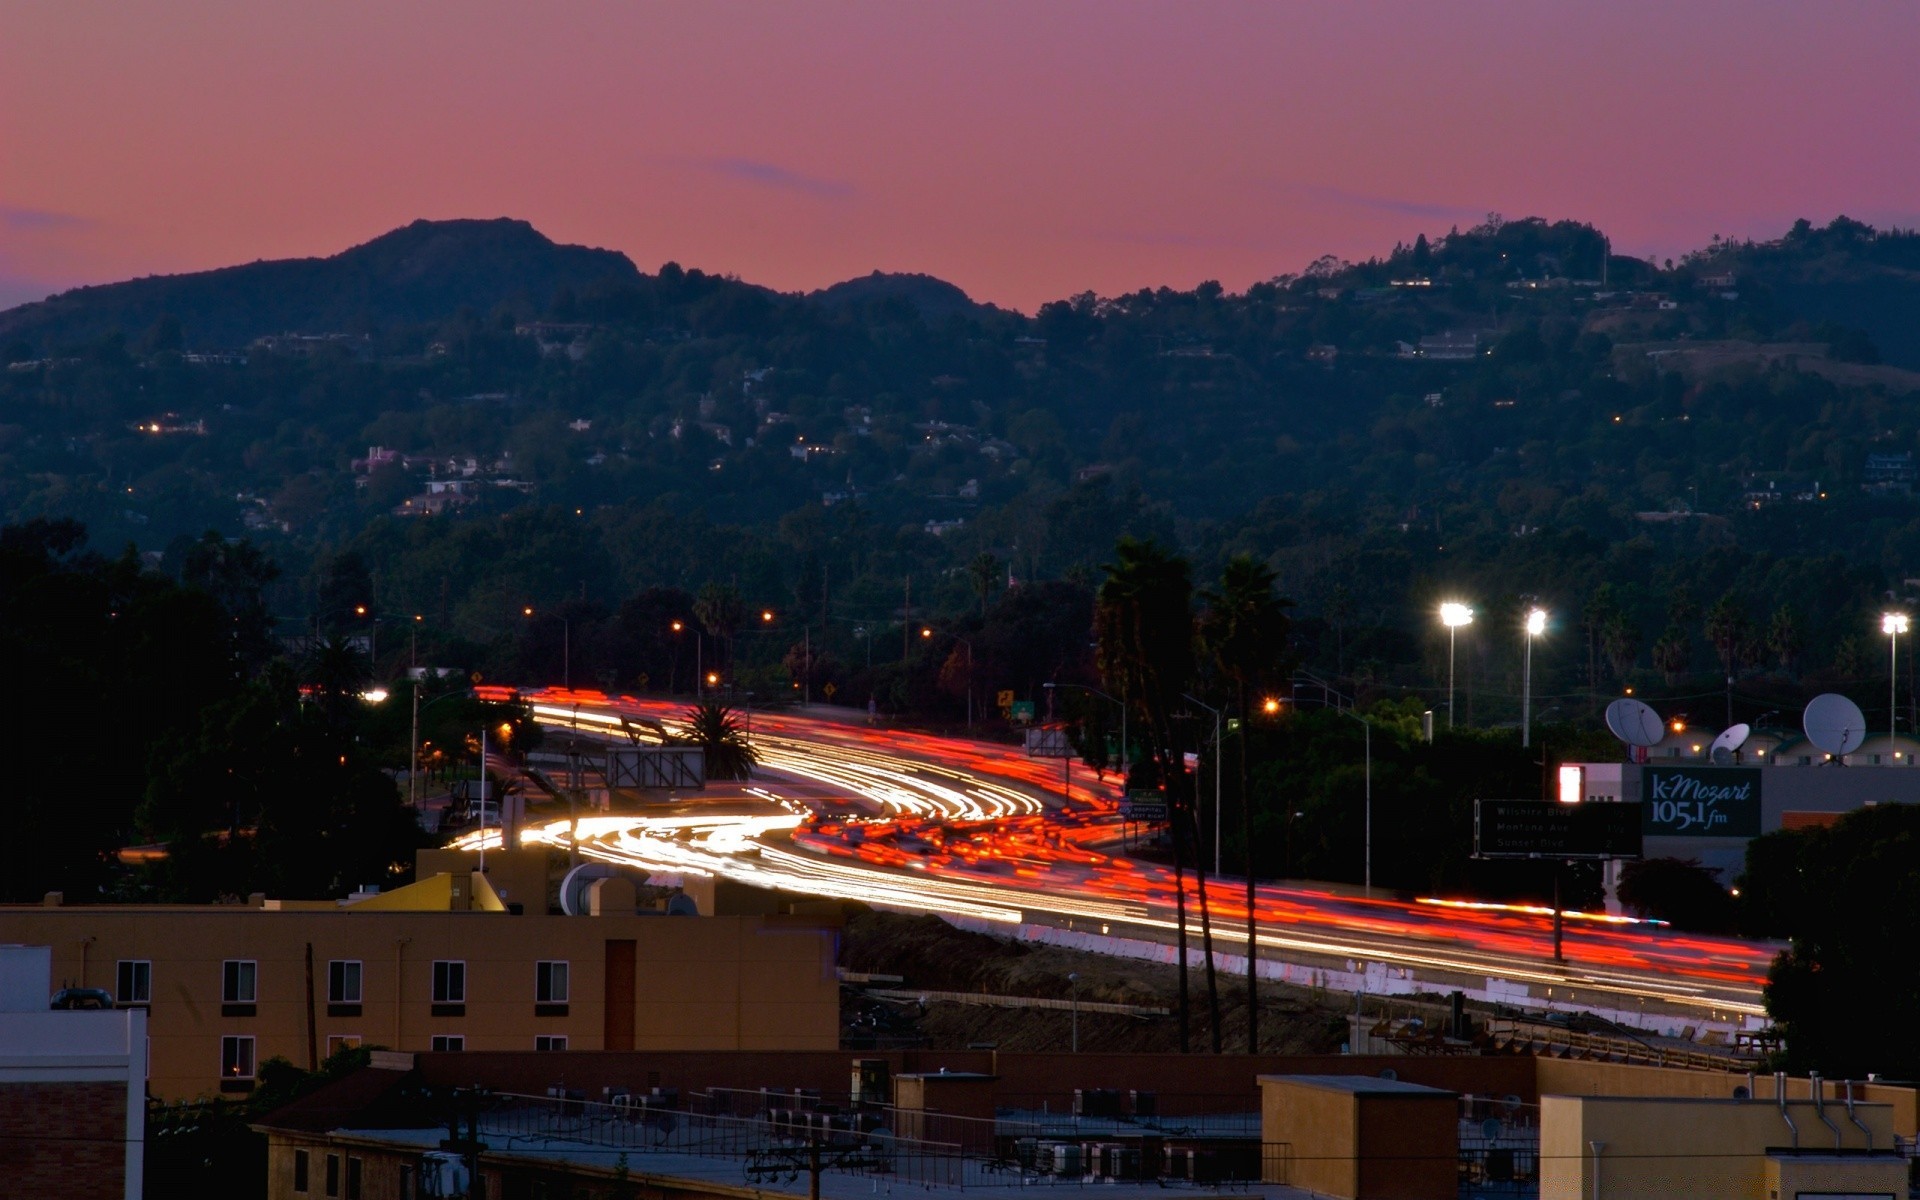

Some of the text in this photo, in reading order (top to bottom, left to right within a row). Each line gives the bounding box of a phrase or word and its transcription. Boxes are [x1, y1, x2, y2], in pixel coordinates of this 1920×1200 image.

[1652, 773, 1751, 806] k-Mozart
[1497, 807, 1542, 816] Wilshire
[1547, 807, 1572, 816] Blvd
[1651, 800, 1728, 830] 105.1 fm
[1497, 822, 1544, 832] Montana
[1549, 823, 1569, 832] Ave
[1497, 838, 1534, 847] Sunset
[1540, 838, 1564, 847] Blvd
